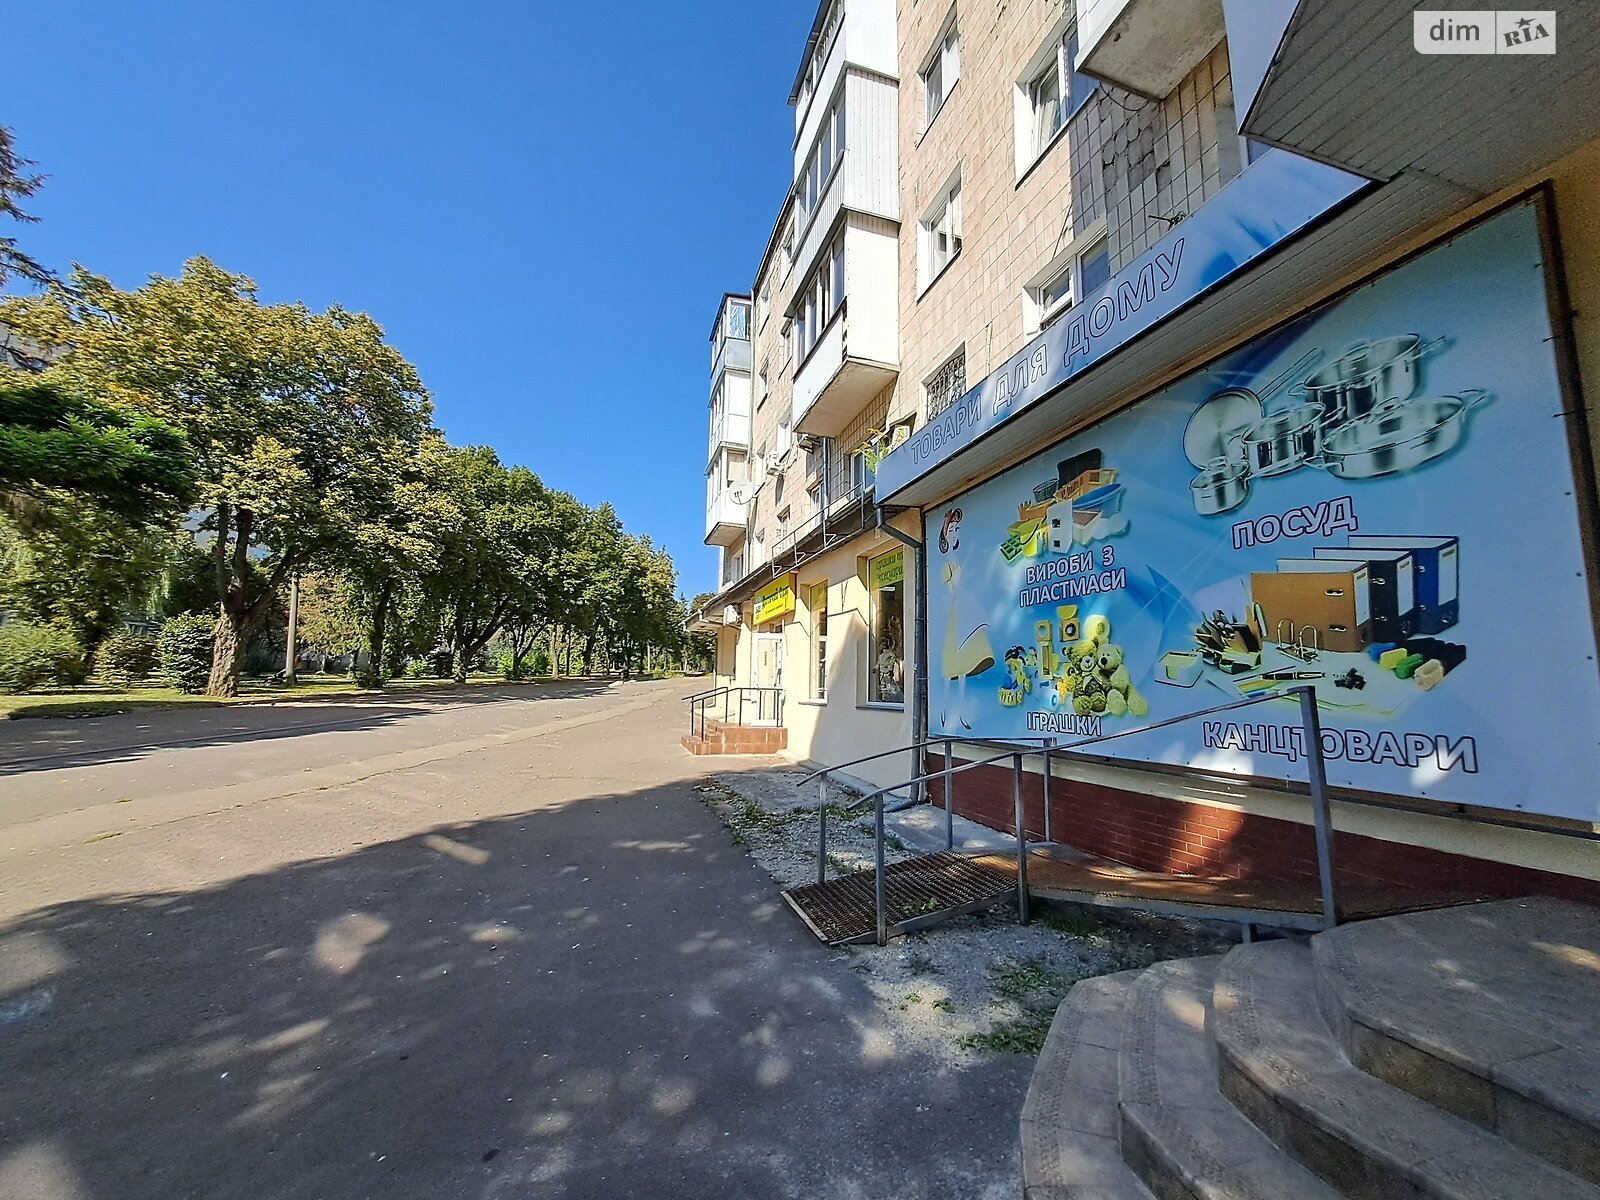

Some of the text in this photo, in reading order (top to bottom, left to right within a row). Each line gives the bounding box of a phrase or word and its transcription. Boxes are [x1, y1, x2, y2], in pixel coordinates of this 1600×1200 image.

[911, 238, 1185, 465] ТОВАРИ ДЛЯ ДОМУ
[1232, 496, 1358, 549] ПОСУД
[1019, 567, 1126, 607] ПЛАСТМАСИ
[1026, 545, 1115, 585] ВИРОБИ З
[1026, 712, 1102, 736] ІГРАШКИ
[1203, 721, 1479, 773] КАНЦТОВАРИ
